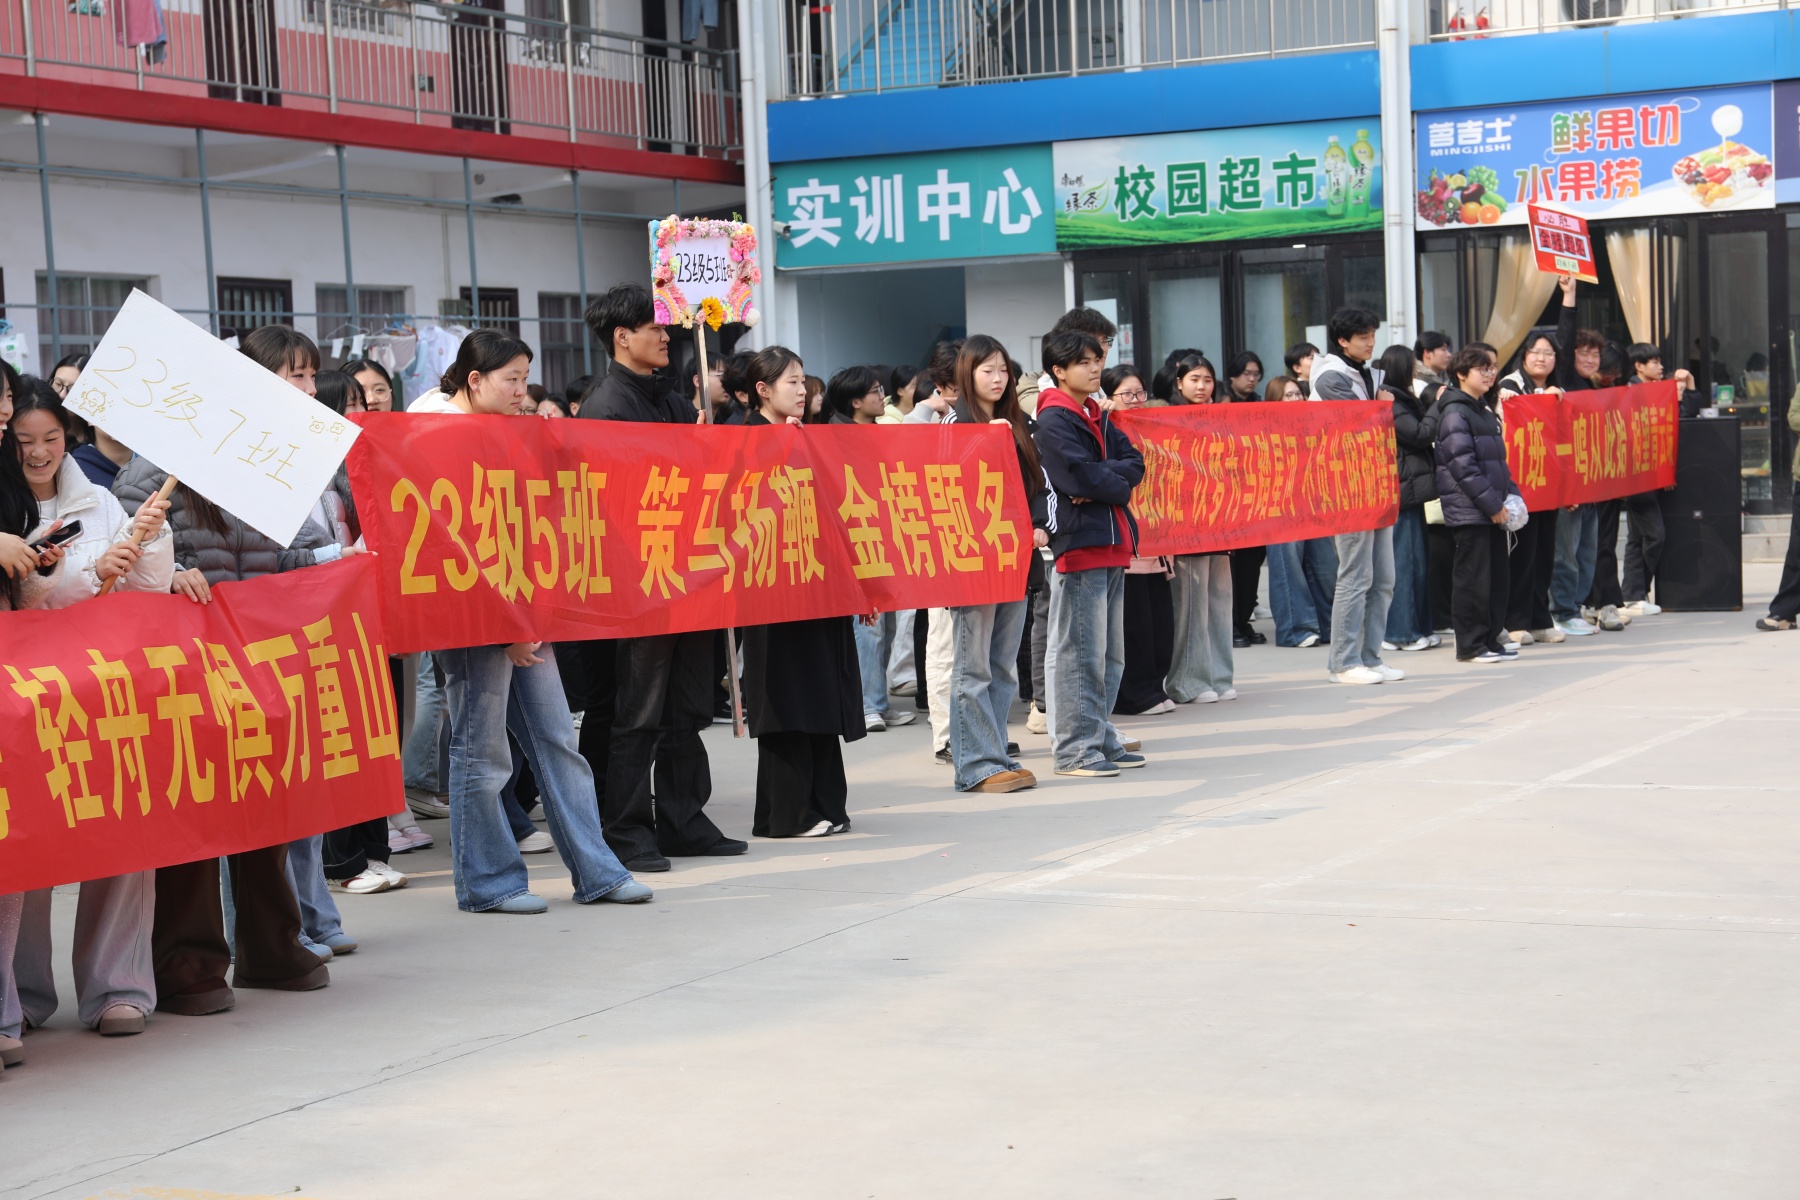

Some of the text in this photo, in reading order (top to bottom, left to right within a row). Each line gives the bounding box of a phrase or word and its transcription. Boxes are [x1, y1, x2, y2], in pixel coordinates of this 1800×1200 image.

[1430, 143, 1512, 157] MINGJISHI
[1551, 103, 1681, 154] 鲜果切
[786, 167, 1043, 249] 实训中心
[1114, 152, 1318, 221] 校园超市
[1514, 157, 1642, 205] 水果捞
[1544, 213, 1572, 229] 必胜
[675, 252, 728, 285] 23级5班
[93, 346, 301, 491] 23级7班
[1503, 417, 1547, 491] 1班
[1555, 410, 1627, 486] 一鸣从此始
[1190, 430, 1298, 527] 以梦为马踏星河
[390, 459, 1020, 603] 23级5班 策马扬鞭 金榜题名
[2, 611, 401, 829] 轻舟无惧万重山
